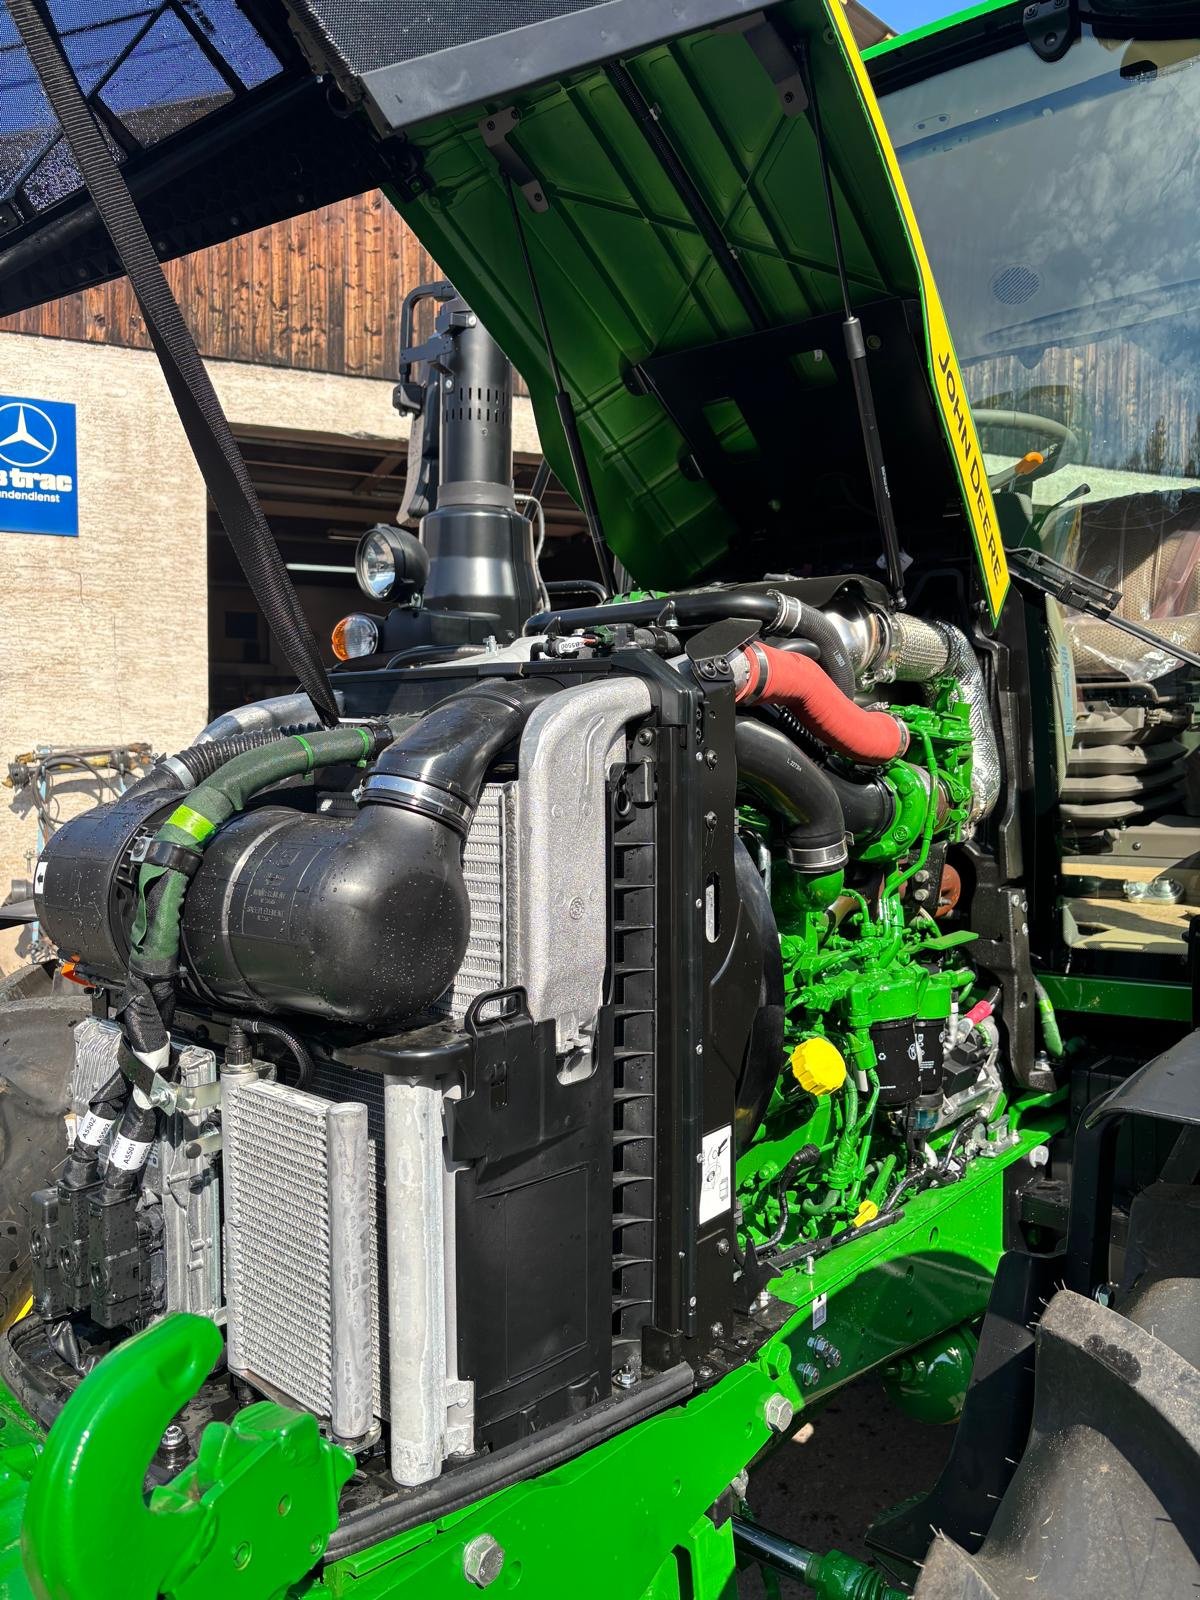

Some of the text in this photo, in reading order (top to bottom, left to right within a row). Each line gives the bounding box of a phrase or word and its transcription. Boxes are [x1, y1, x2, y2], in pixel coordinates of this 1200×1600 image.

[938, 352, 1002, 585] JOHN DEERE
[9, 467, 73, 493] trac
[0, 490, 60, 503] ndendienst
[82, 1117, 97, 1139] A5502
[124, 1143, 136, 1165] A5501
